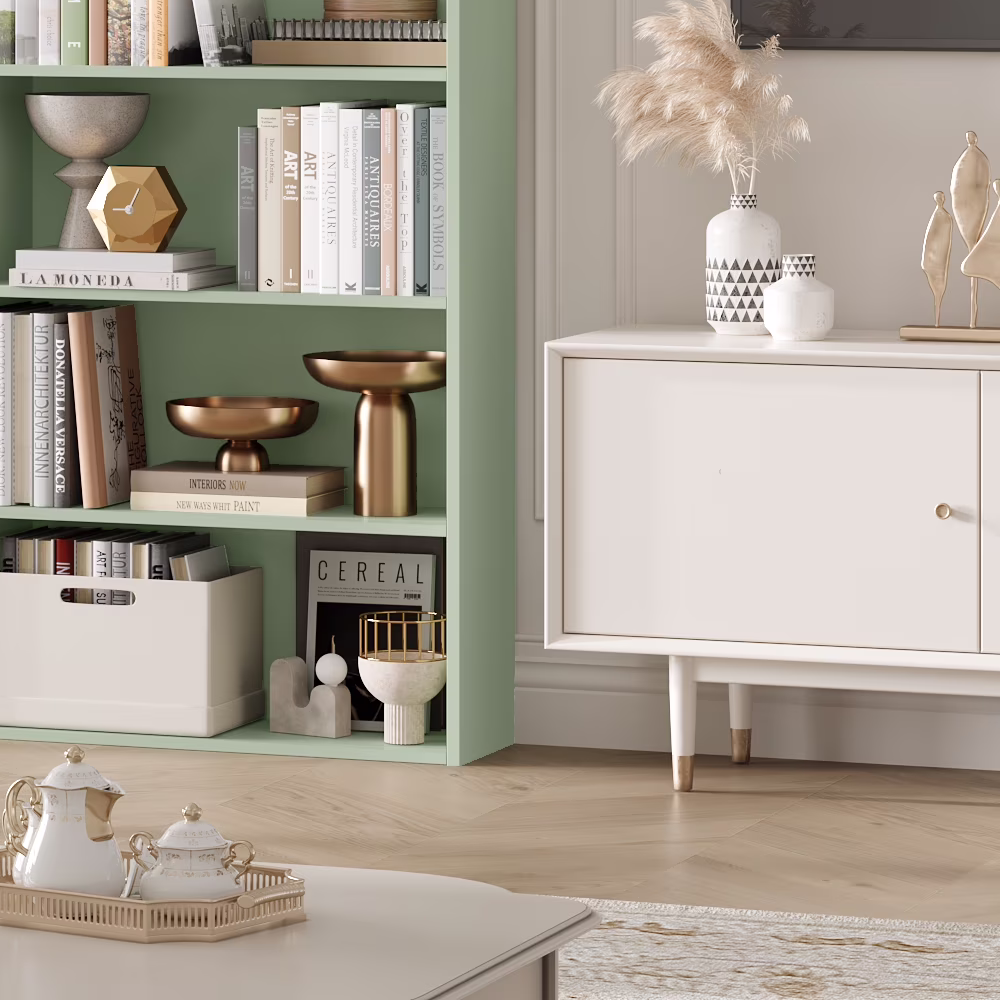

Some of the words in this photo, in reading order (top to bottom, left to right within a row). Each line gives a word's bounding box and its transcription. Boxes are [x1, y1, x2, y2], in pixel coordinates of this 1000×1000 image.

[283, 150, 298, 180] ART
[304, 151, 317, 180] ART
[368, 156, 380, 248] ANTIQUAIRES
[383, 183, 393, 232] BORDEAUX
[21, 272, 47, 285] LA
[53, 273, 134, 288] MONEDA
[55, 339, 66, 423] DONATELLA
[34, 324, 49, 479] INNENARCHITEKTUR
[55, 427, 66, 493] VERSACE
[189, 478, 227, 490] INTERIORS
[229, 480, 247, 491] NOW
[176, 500, 192, 509] NEW
[194, 501, 211, 510] WAYS
[212, 502, 230, 511] WHIT
[233, 501, 261, 512] PAINT
[318, 560, 424, 584] CEREAL
